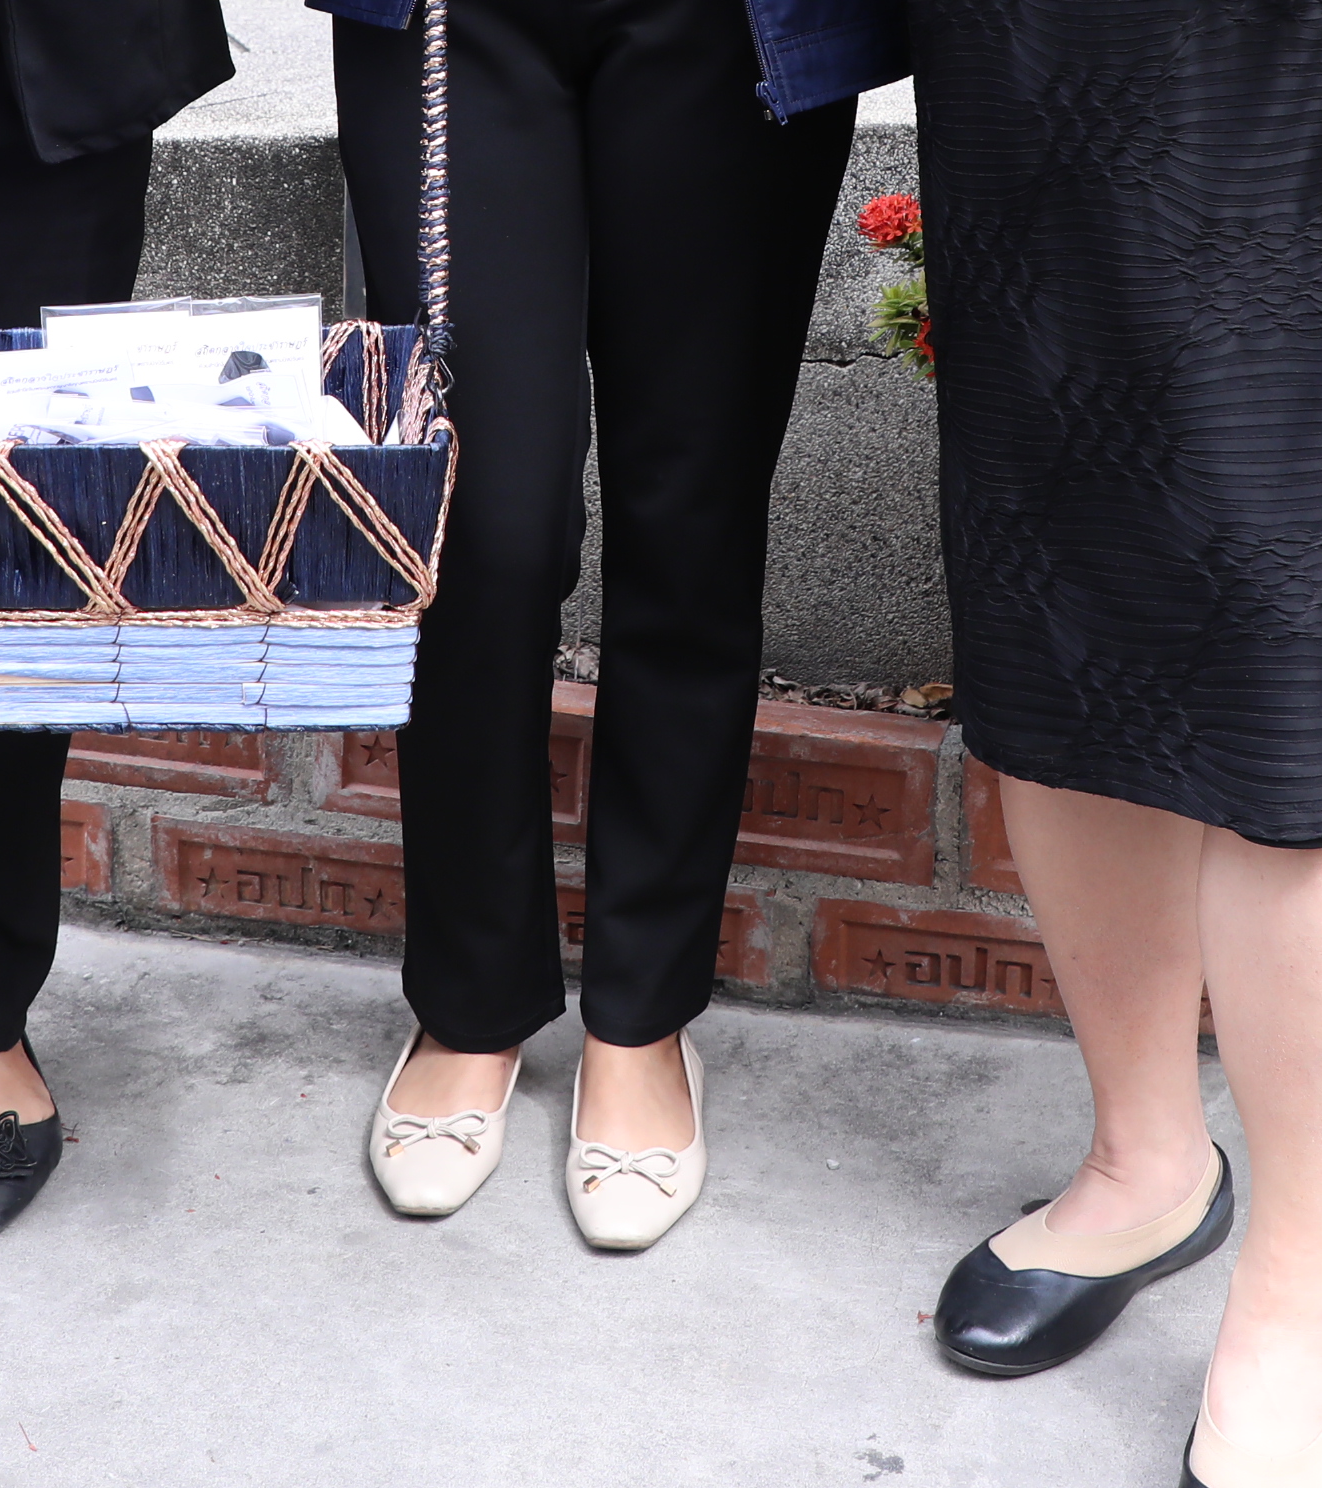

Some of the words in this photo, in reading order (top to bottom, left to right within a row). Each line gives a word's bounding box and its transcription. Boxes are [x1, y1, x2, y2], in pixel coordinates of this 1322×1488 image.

[742, 771, 845, 825] ปก
[236, 866, 354, 915] อปก
[904, 947, 1033, 998] อปก
